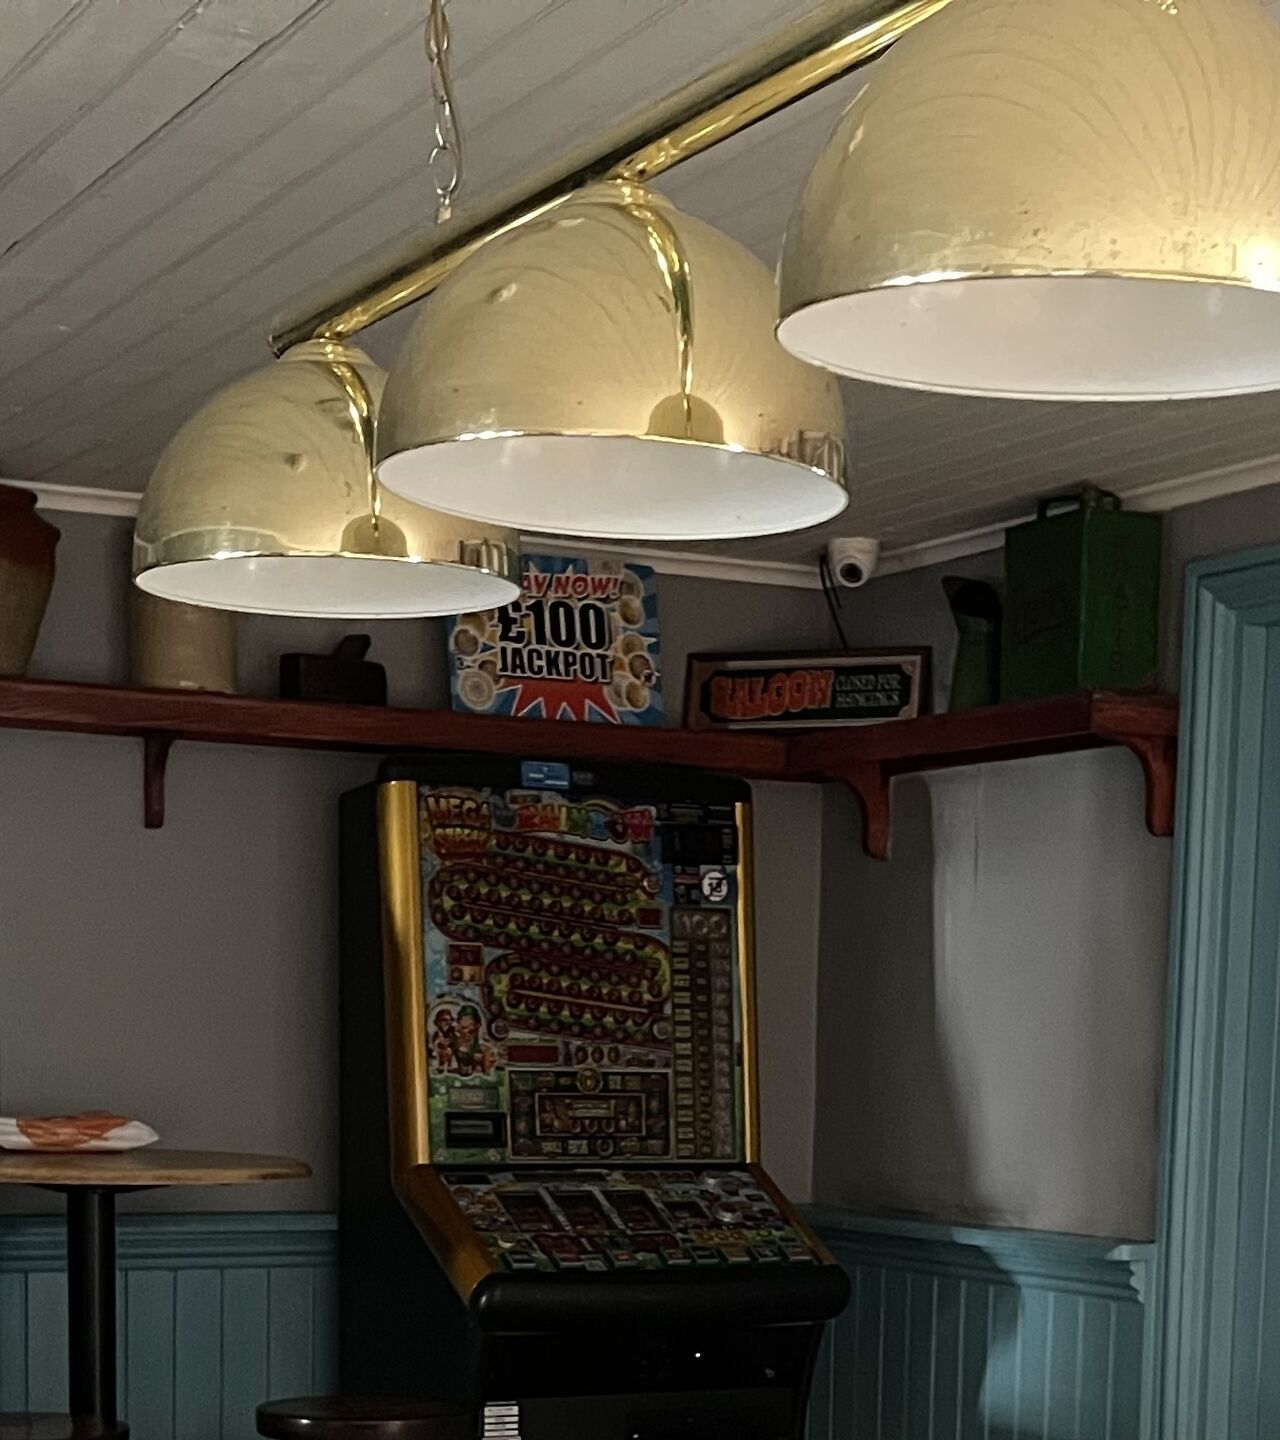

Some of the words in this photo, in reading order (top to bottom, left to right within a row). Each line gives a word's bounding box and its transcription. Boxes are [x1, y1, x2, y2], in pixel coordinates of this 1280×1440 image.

[551, 574, 623, 599] NOW!
[497, 601, 608, 651] £100
[499, 645, 613, 682] JACKPOT
